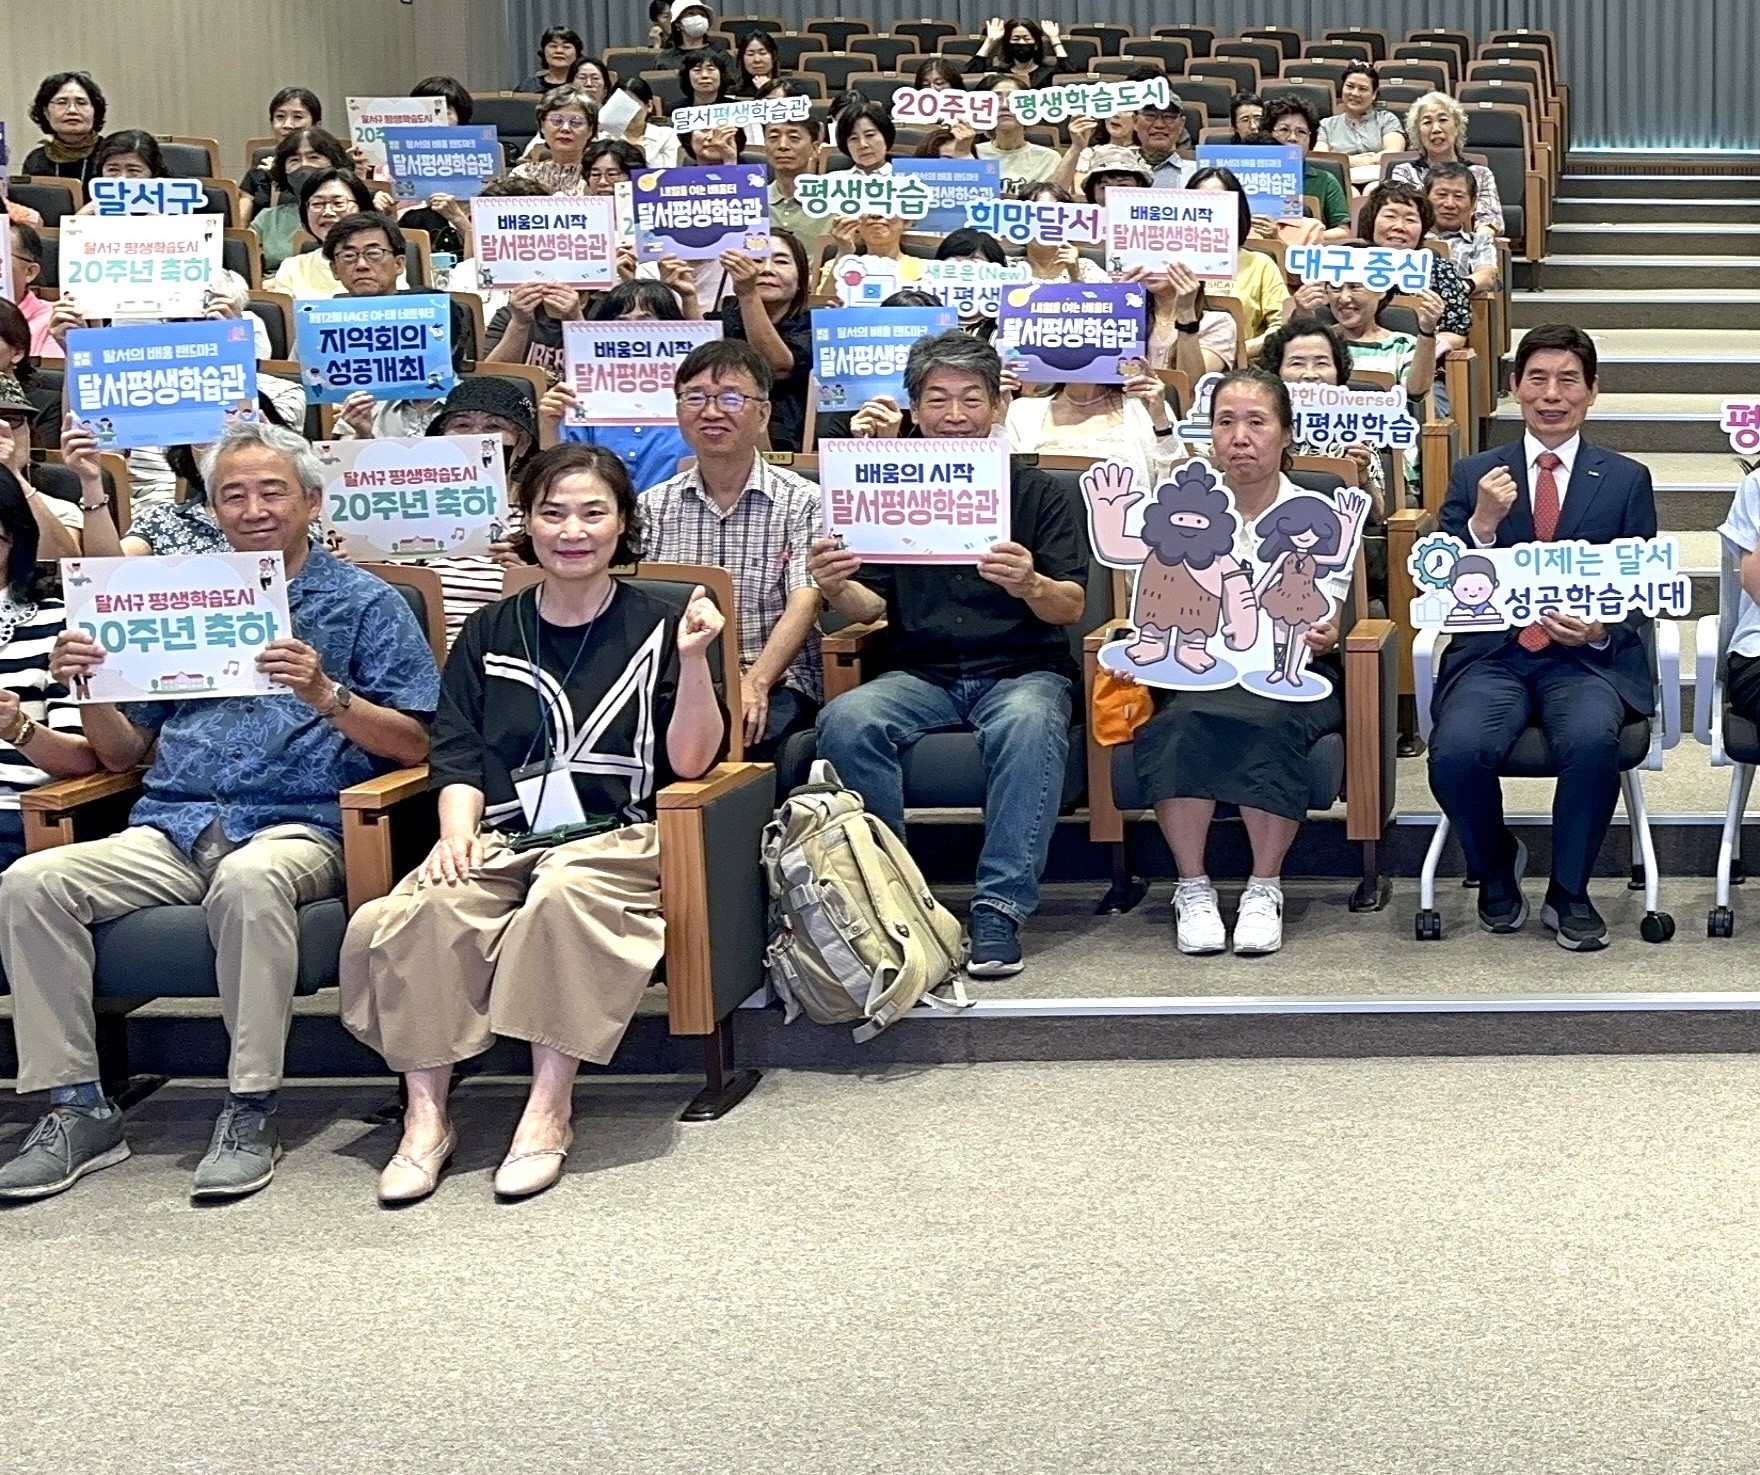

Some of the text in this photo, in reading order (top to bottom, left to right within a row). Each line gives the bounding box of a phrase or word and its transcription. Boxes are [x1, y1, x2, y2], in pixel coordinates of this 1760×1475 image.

[674, 99, 809, 126] 달서평생학습관
[898, 92, 993, 124] 20주년
[1015, 81, 1166, 119] 평생학습도시
[392, 153, 494, 177] 달서평생학습관
[94, 182, 204, 215] 달서구
[799, 178, 929, 214] 평생학습
[498, 214, 587, 230] 배움의 시작
[638, 198, 763, 229] 달서평생학습관
[971, 202, 1098, 240] 희망달서
[1130, 205, 1213, 222] 배움의 시작
[84, 240, 199, 255] 달서구 평생학습도시
[481, 234, 608, 262] 달서평생학습관
[1113, 224, 1230, 253] 달서평생학습관
[68, 257, 212, 284] 20주년 축하
[1290, 249, 1428, 288] 대구 중심
[320, 324, 427, 354] 지역회의
[1003, 317, 1138, 348] 달서평생학습관
[103, 343, 219, 364] 달서의 배움 랜드마크
[594, 341, 694, 358] 배움의 시작
[326, 355, 425, 386] 성공개최
[77, 364, 247, 411] 달서평생학습관
[343, 465, 478, 487] 달서구 평생학습도시
[855, 463, 975, 484] 배움의 시작
[329, 485, 498, 522] 20주년 축하
[831, 489, 999, 526] 달서평생학습관
[1514, 542, 1673, 577] 이제는 달서
[95, 588, 256, 613] 달서구 평생학습도시
[1504, 580, 1685, 621] 성공학습시대
[204, 611, 279, 648] 축하
